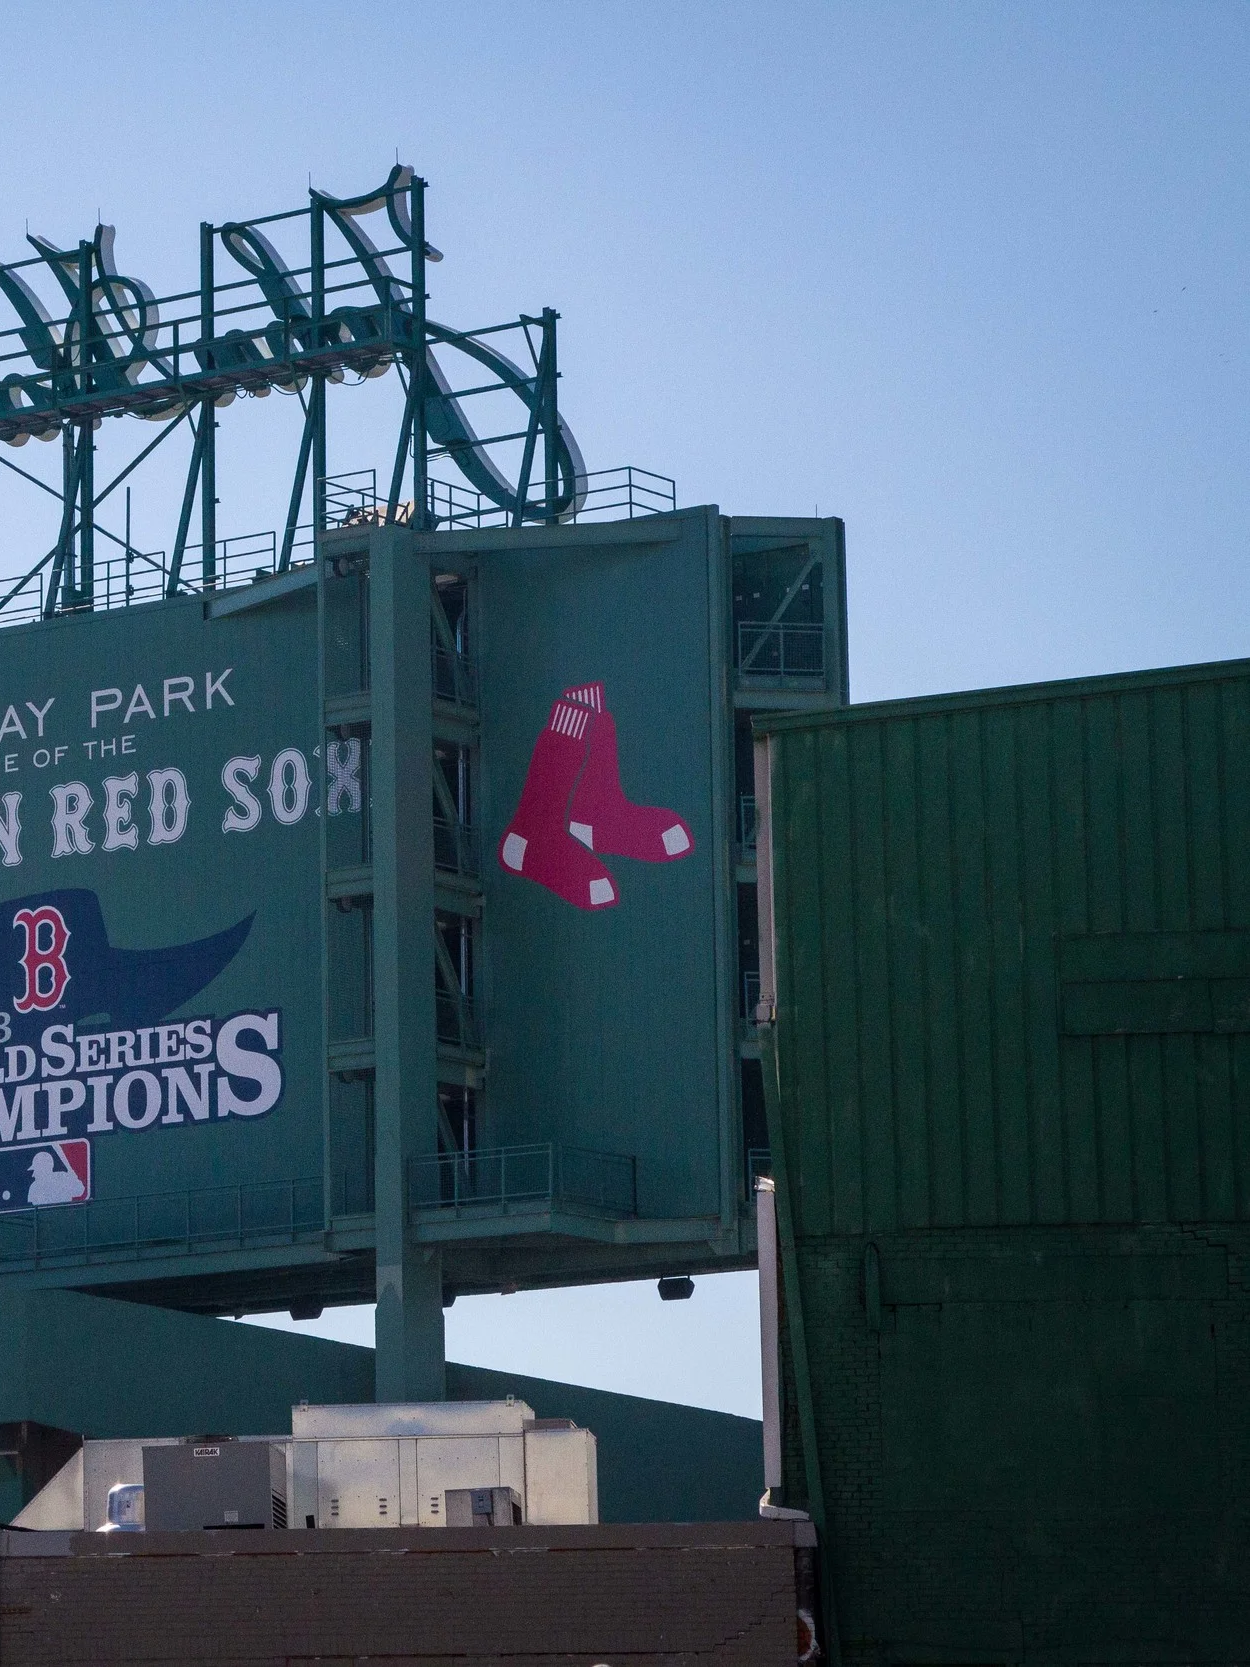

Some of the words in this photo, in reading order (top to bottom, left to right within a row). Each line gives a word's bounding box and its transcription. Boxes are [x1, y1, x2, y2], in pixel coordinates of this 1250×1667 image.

[90, 668, 236, 729] PARK
[33, 746, 69, 769] OF
[83, 734, 138, 760] THE
[49, 767, 192, 858] RED
[221, 738, 372, 834] SOX
[13, 905, 71, 1014] B
[41, 1020, 214, 1079] SERIES
